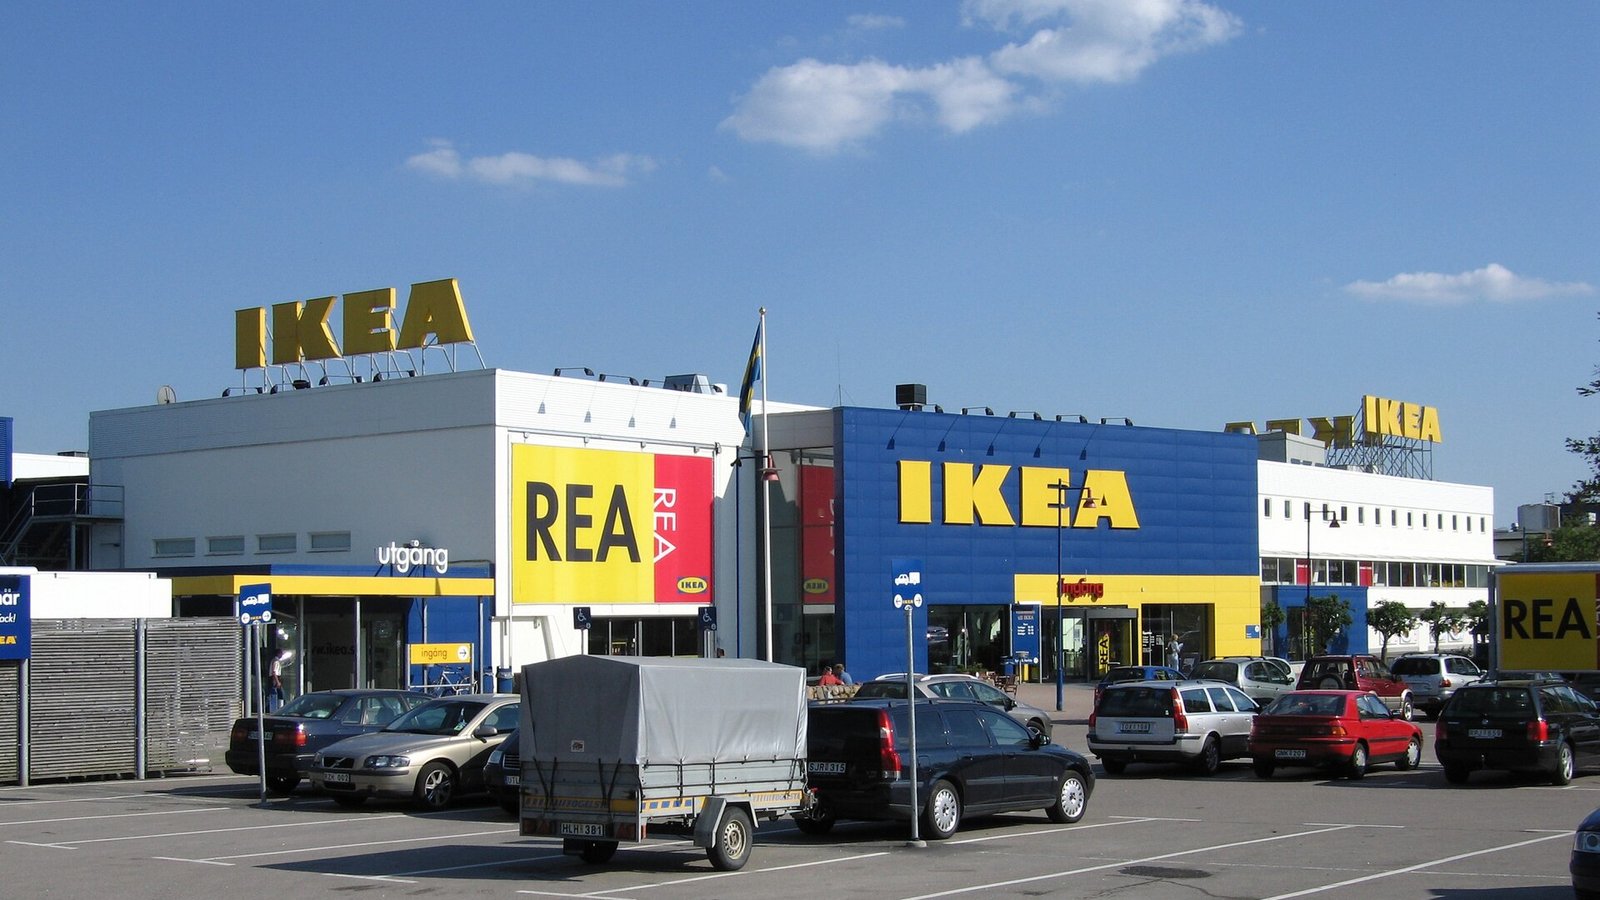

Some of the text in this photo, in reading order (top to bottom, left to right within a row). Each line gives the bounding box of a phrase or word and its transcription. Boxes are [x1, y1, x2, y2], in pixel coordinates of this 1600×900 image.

[235, 278, 474, 369] IKEA
[1363, 395, 1442, 443] IKEA
[898, 460, 1140, 529] IKEA
[526, 481, 641, 563] REA
[654, 488, 677, 564] REA
[378, 540, 448, 574] utgång
[681, 581, 704, 589] IKEA
[0, 612, 17, 623] ock!
[1503, 597, 1592, 639] REA
[421, 647, 448, 660] ingång
[1100, 639, 1109, 664] REA
[809, 763, 845, 773] SJR 315
[562, 823, 603, 834] HLH 381
